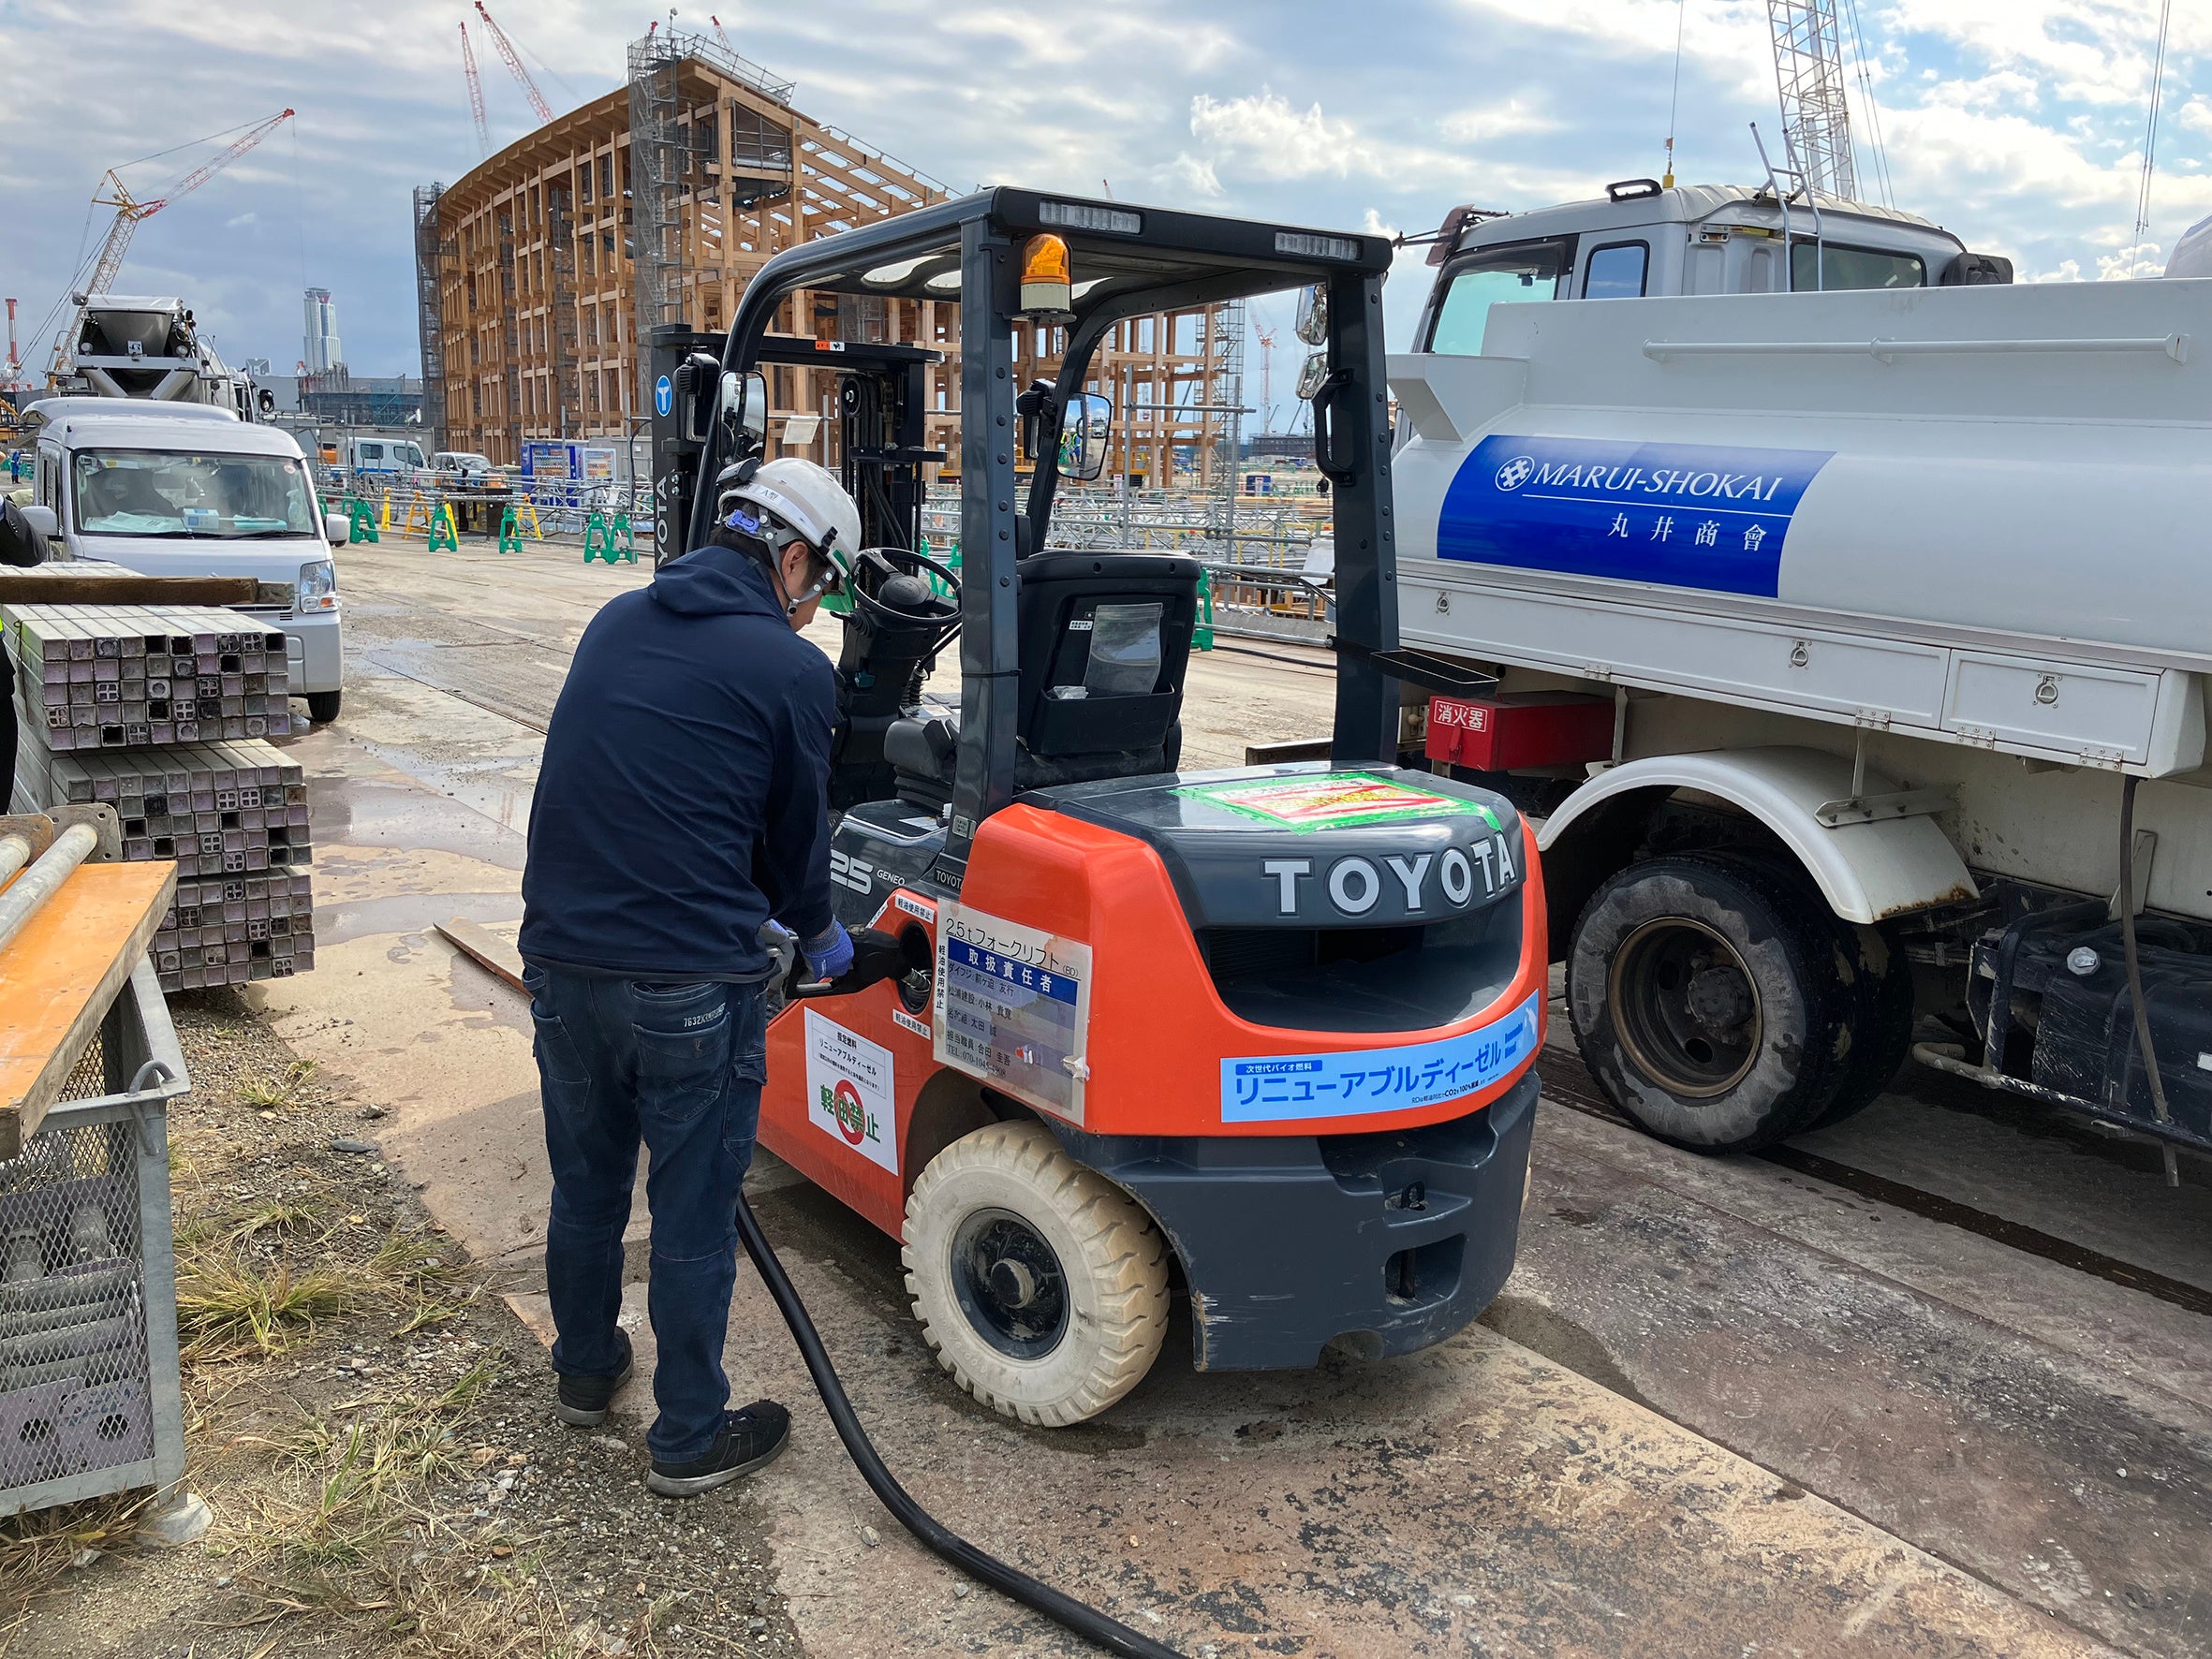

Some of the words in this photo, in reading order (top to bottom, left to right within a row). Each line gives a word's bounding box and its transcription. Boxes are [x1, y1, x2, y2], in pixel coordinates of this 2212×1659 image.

[1532, 462, 1782, 502] MARUI-SHOKAI
[656, 476, 668, 565] YOTA
[1607, 512, 1767, 552] 丸井商會
[1438, 704, 1483, 729] 消火器
[831, 849, 873, 895] 25
[877, 869, 906, 886] GENEO
[936, 870, 963, 890] TOYOT
[1264, 832, 1516, 912] TOYOTA
[968, 947, 1053, 993] 取扱責任者
[1236, 1041, 1502, 1105] リニューアブルディーゼル
[1246, 1062, 1312, 1074] 次世代バイオ燃料
[819, 1083, 881, 1144] 軽油禁止
